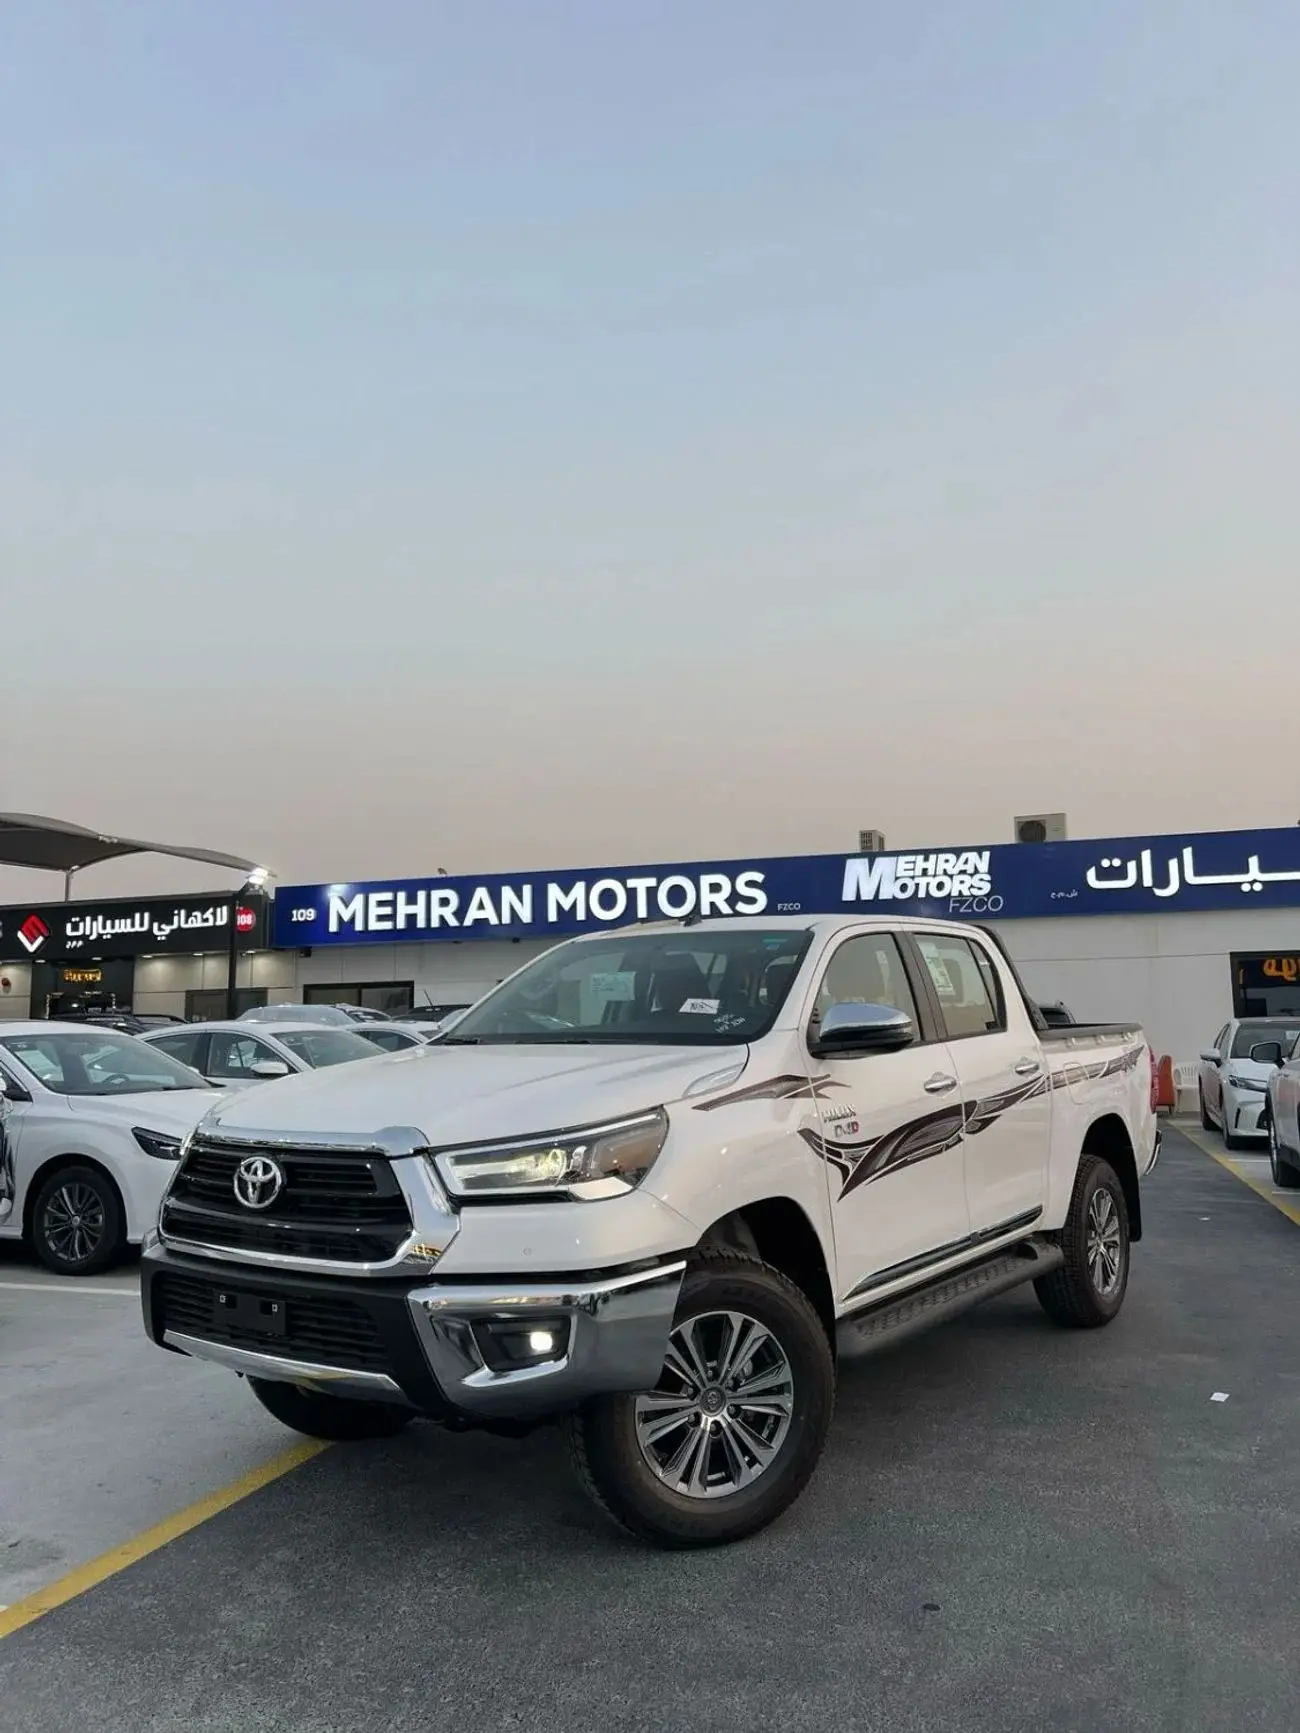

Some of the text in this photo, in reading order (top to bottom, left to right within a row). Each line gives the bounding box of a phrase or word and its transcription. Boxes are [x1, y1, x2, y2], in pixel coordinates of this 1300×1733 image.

[291, 871, 768, 933] 109 MEHRAN MOTORS
[777, 902, 801, 912] FZCO
[949, 895, 1003, 913] FZCO
[65, 905, 228, 941] لاكهاني للسيارات
